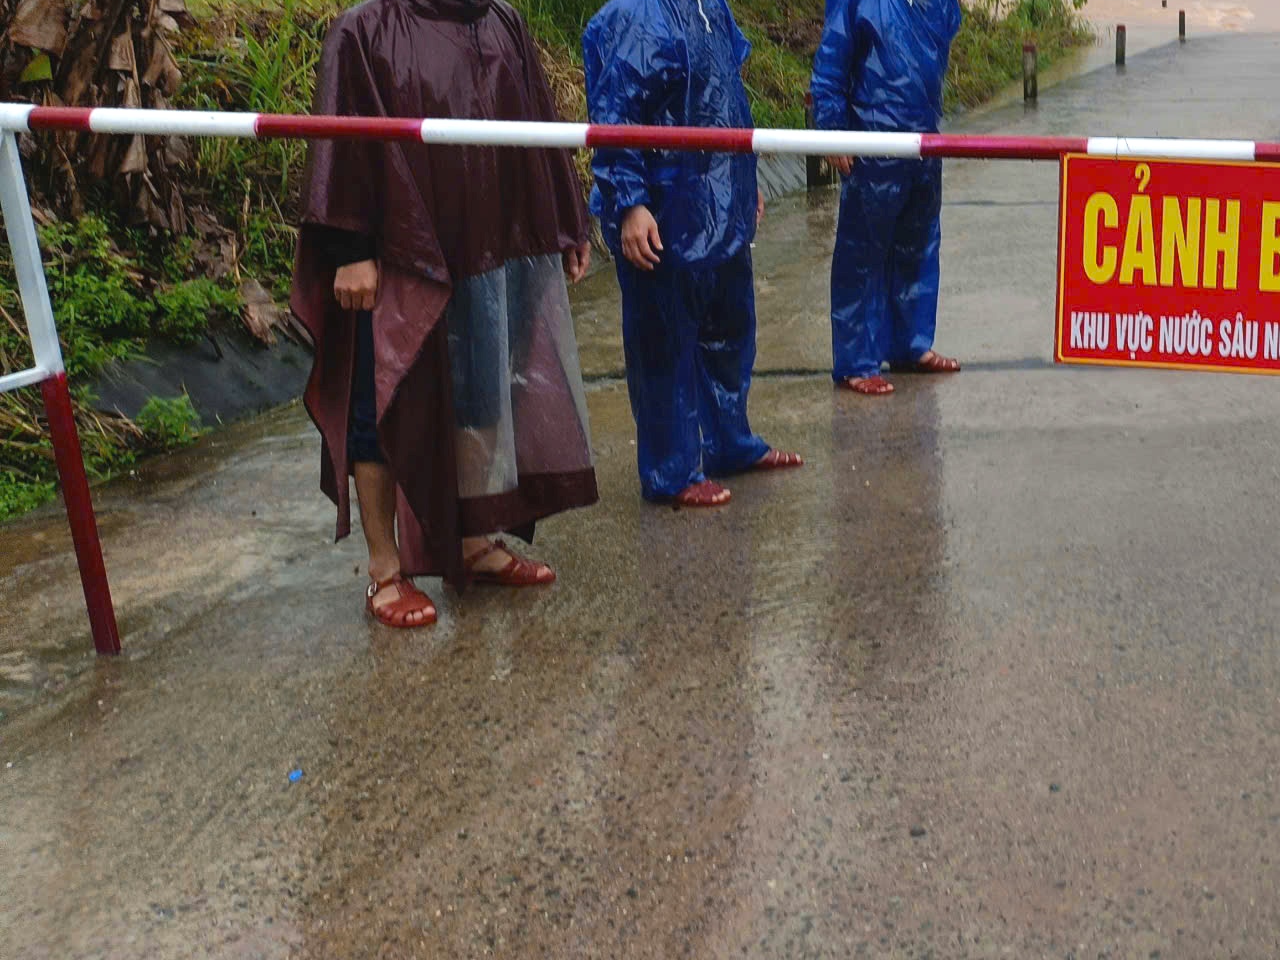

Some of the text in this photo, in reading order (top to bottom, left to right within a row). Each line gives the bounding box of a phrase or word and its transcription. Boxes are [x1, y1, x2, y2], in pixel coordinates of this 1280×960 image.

[1083, 163, 1241, 290] CẢNH
[1070, 311, 1110, 350] KHU
[1115, 310, 1153, 360] VỰC
[1158, 310, 1213, 357] NƯỚC
[1218, 312, 1258, 358] SÂU
